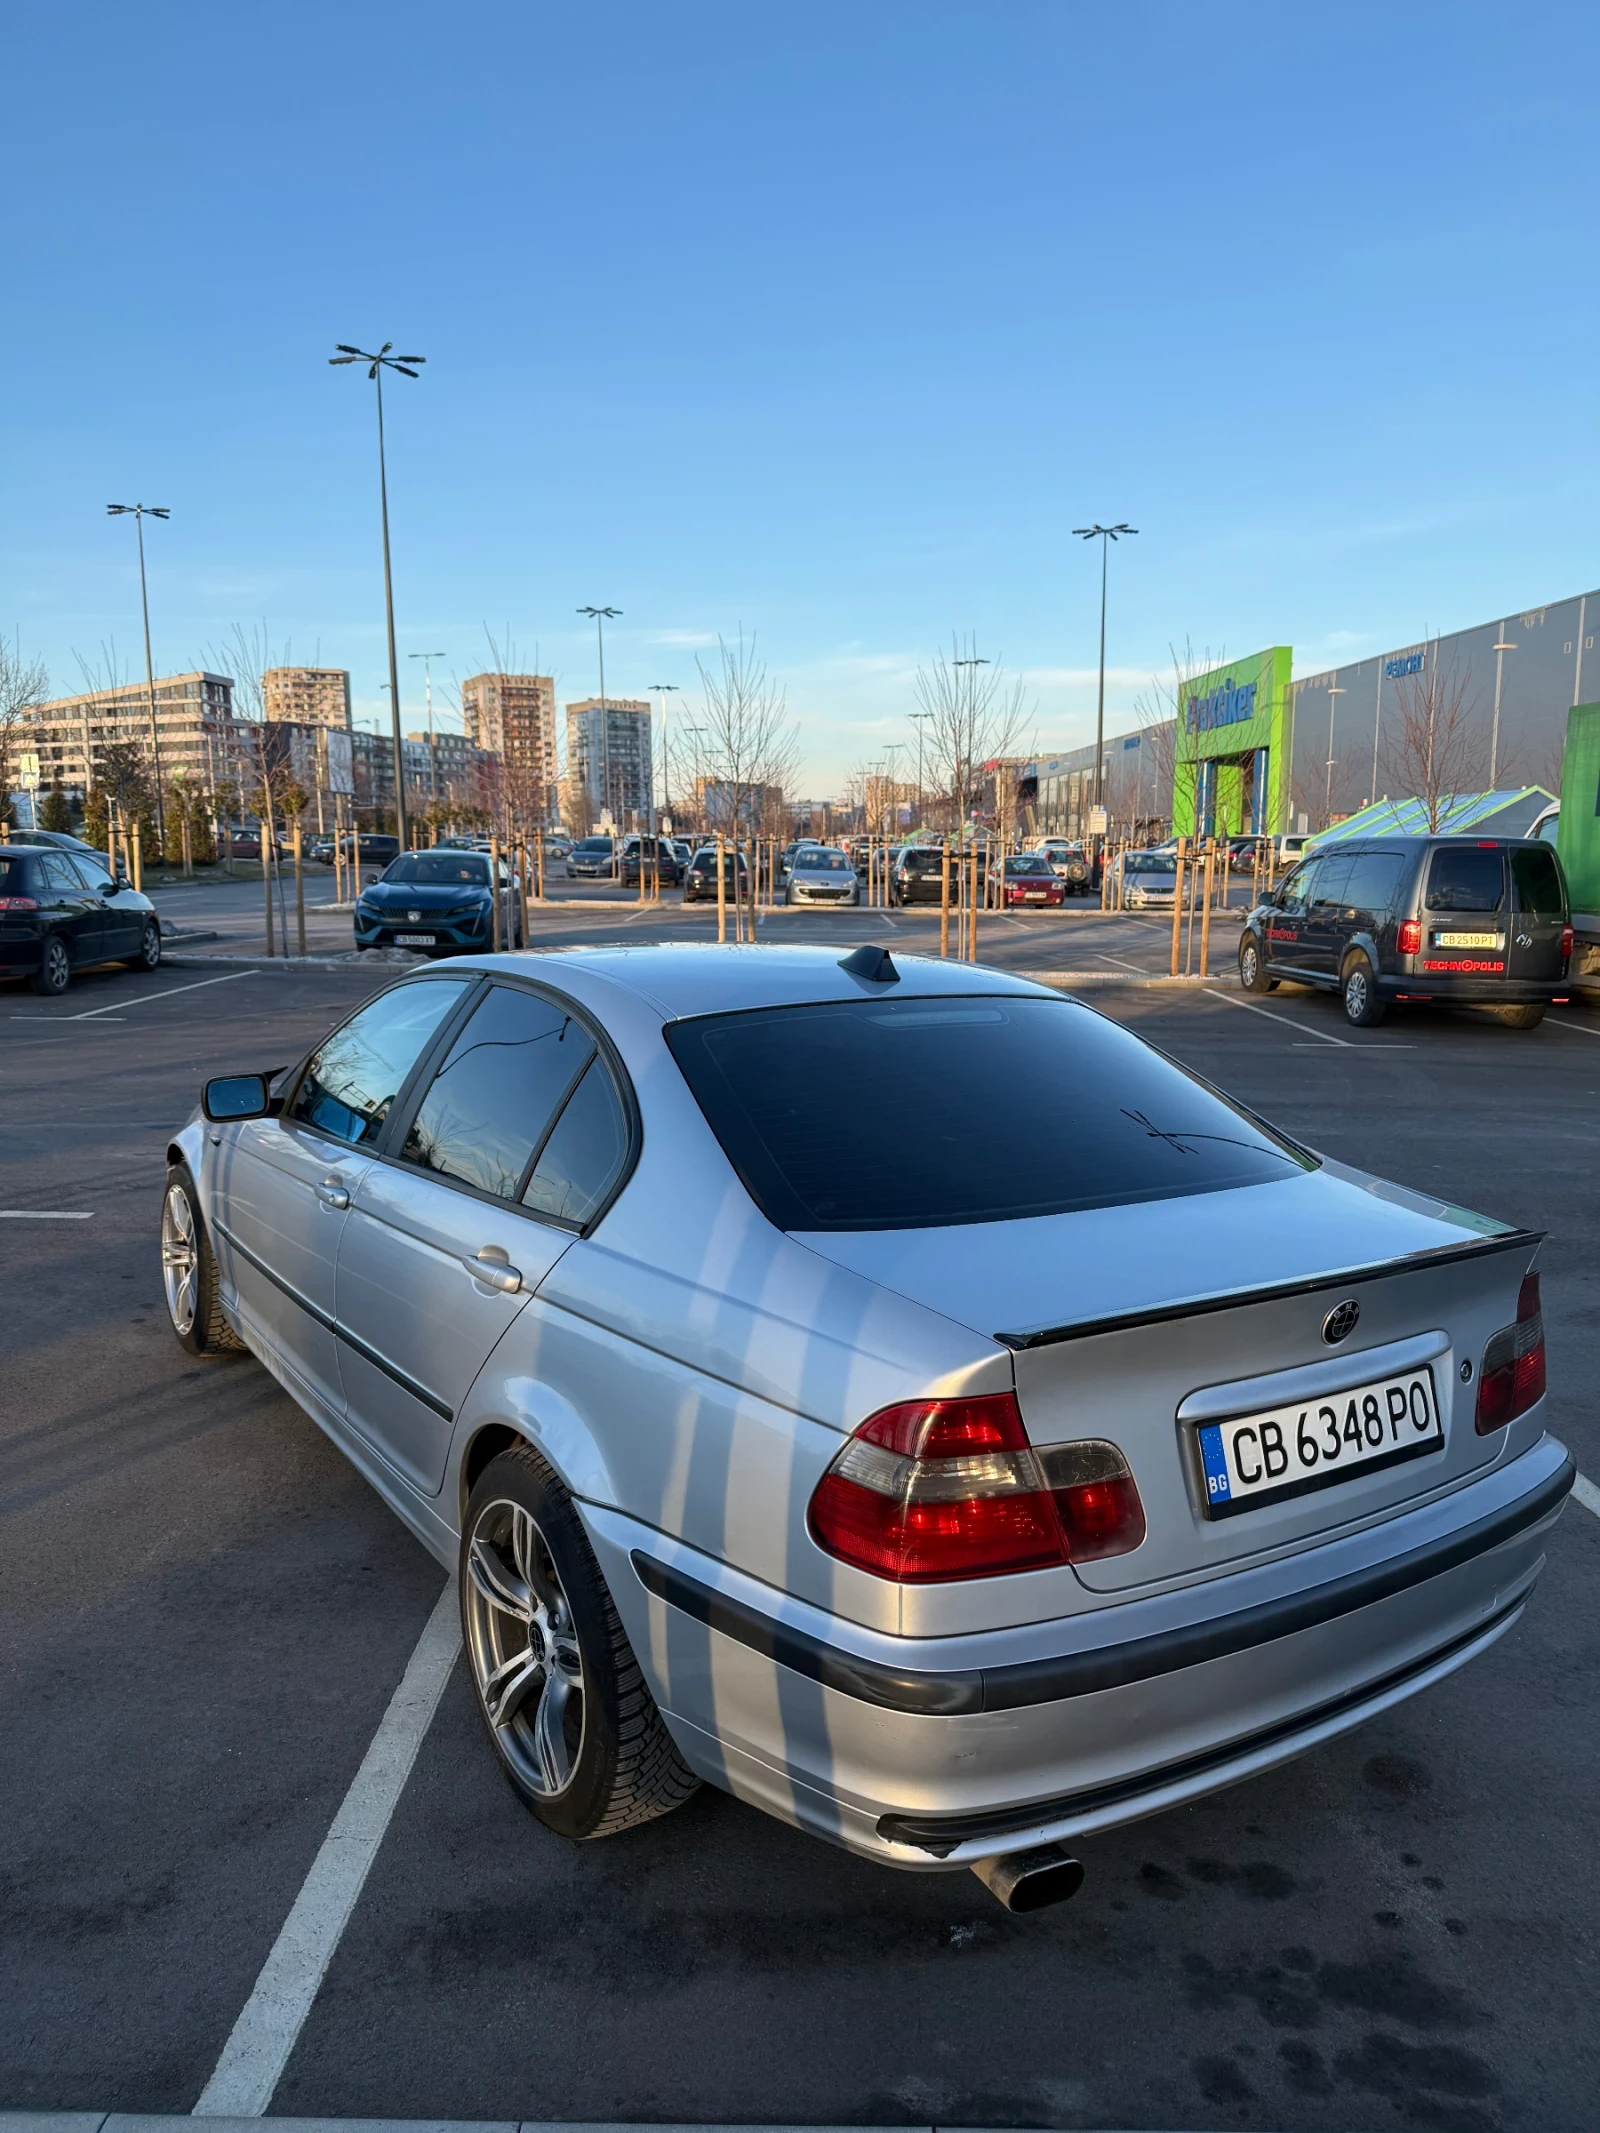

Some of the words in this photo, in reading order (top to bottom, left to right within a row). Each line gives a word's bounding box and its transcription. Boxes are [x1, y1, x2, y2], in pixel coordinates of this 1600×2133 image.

[1442, 935, 1455, 945] CB
[1457, 935, 1480, 945] 2510
[1481, 935, 1494, 946] PT
[1423, 959, 1504, 973] TECHNOPOLIS
[1231, 1420, 1289, 1484] CB
[1296, 1394, 1384, 1467] 6348
[1384, 1380, 1431, 1442] PO
[1207, 1473, 1228, 1494] BG
